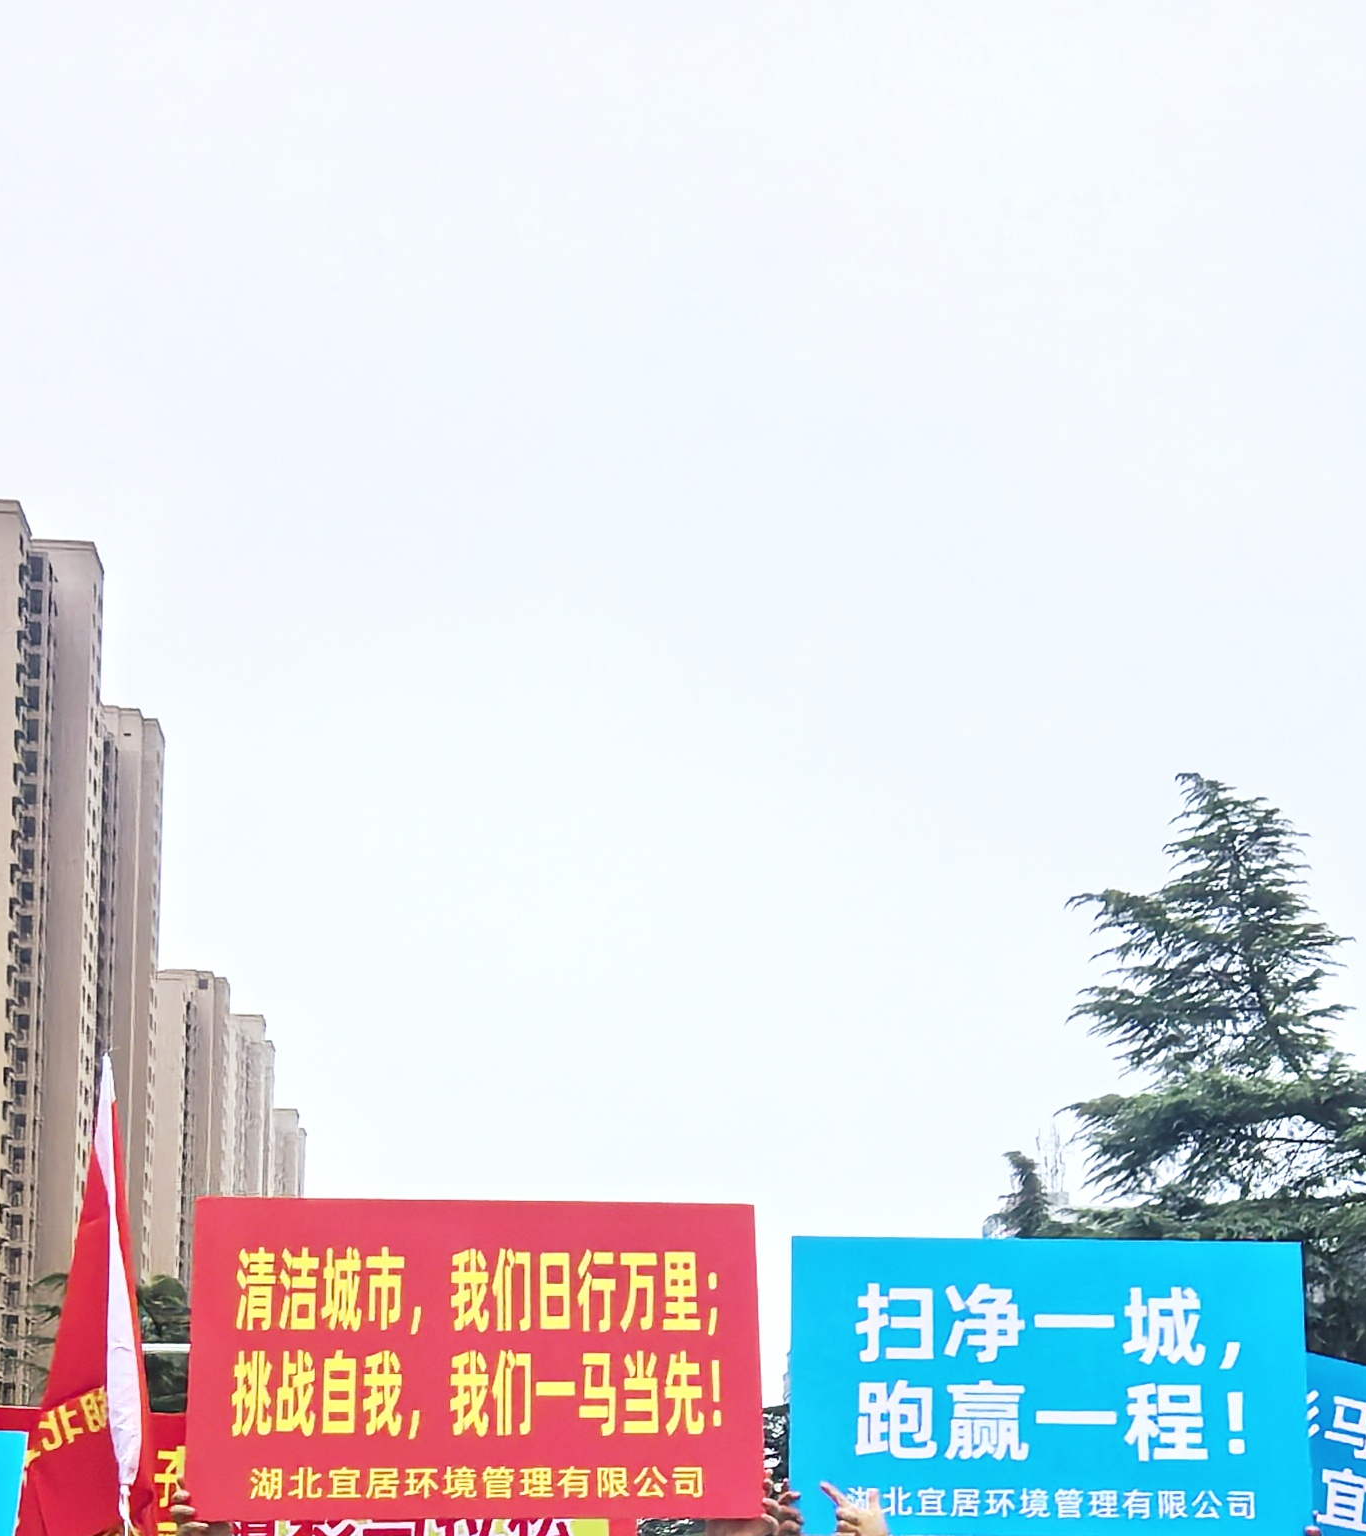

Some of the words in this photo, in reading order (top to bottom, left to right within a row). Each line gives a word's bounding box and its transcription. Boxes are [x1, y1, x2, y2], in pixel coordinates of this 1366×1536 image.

[234, 1247, 719, 1336] 清洁城市，我们日行万里；
[856, 1285, 1242, 1370] 扫净一城，
[231, 1349, 723, 1440] 挑战自我，我们一马当先！
[855, 1382, 1246, 1463] 跑赢一程！
[250, 1467, 704, 1500] 湖北宜居环境管理有限公司
[847, 1487, 1256, 1520] 湖北宜居环境管理有限公司
